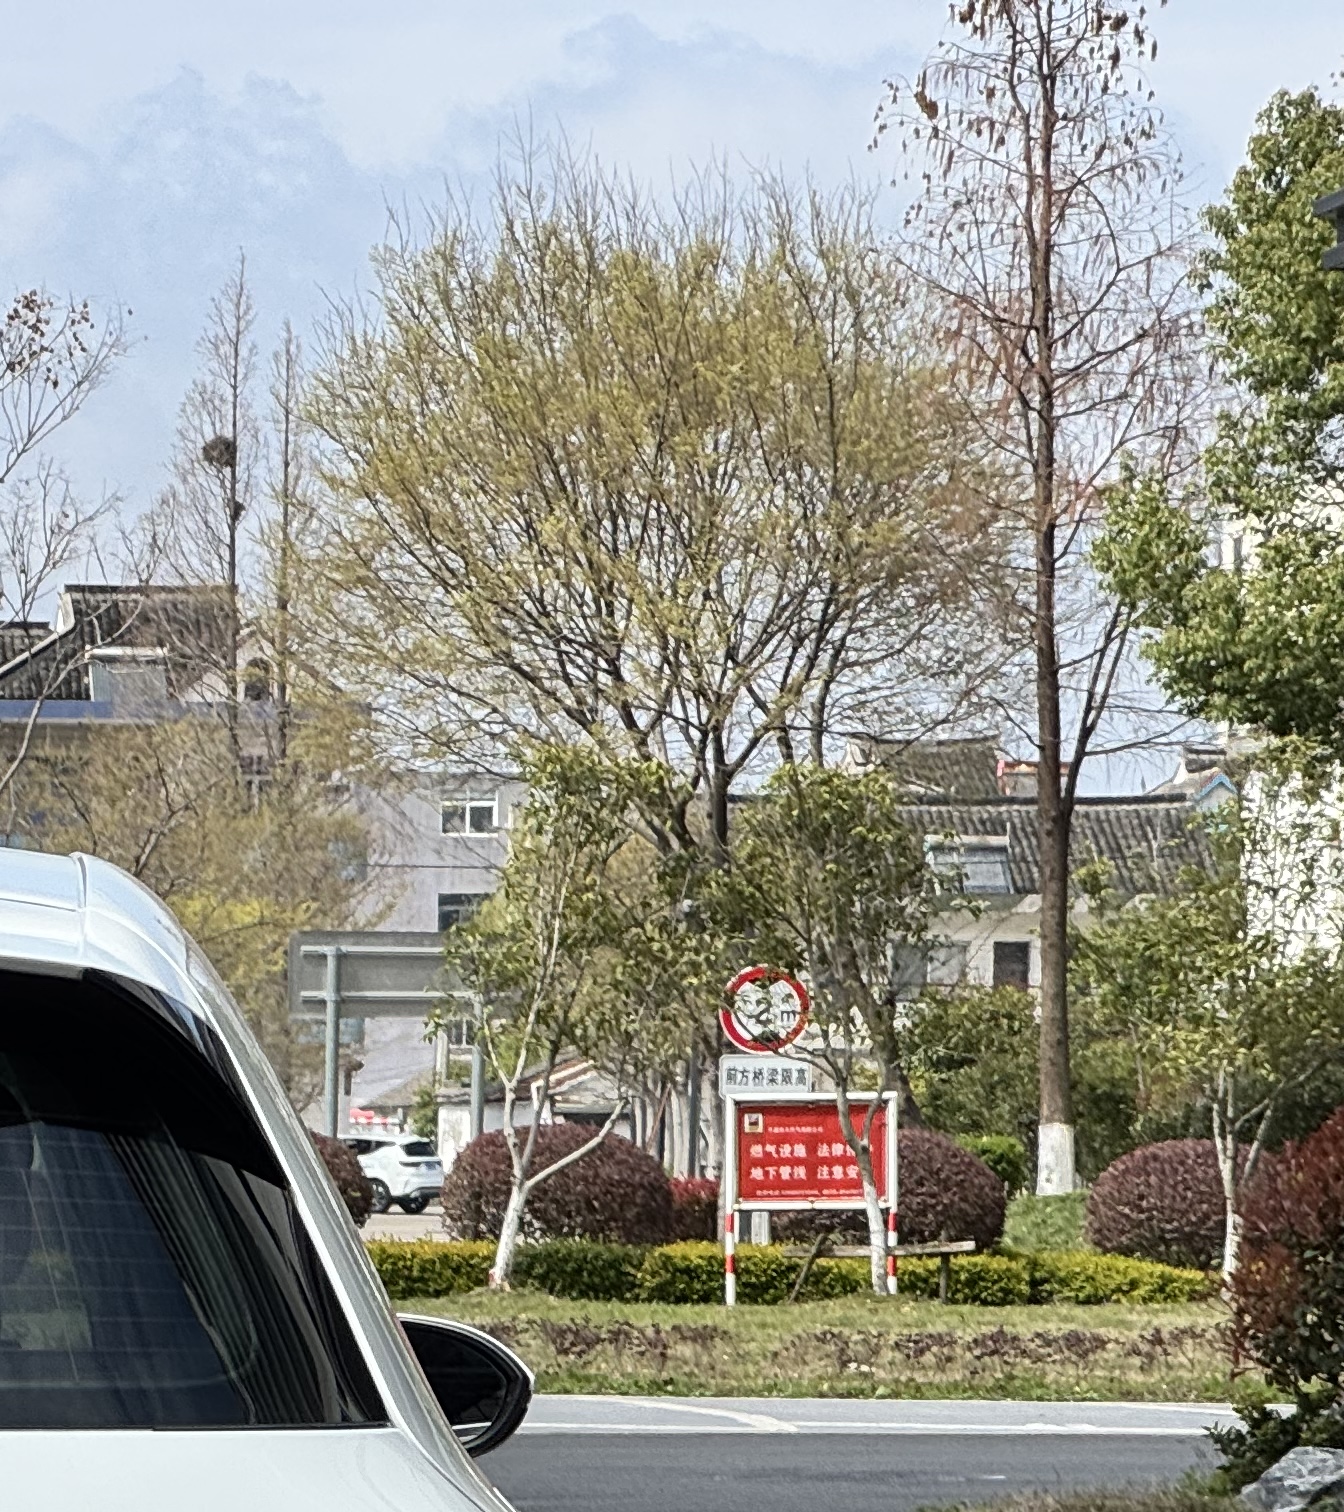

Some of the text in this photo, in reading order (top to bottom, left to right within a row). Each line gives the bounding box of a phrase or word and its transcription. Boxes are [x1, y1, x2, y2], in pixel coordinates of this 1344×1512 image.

[817, 1143, 873, 1157] 法律
[817, 1165, 859, 1179] 注意安
